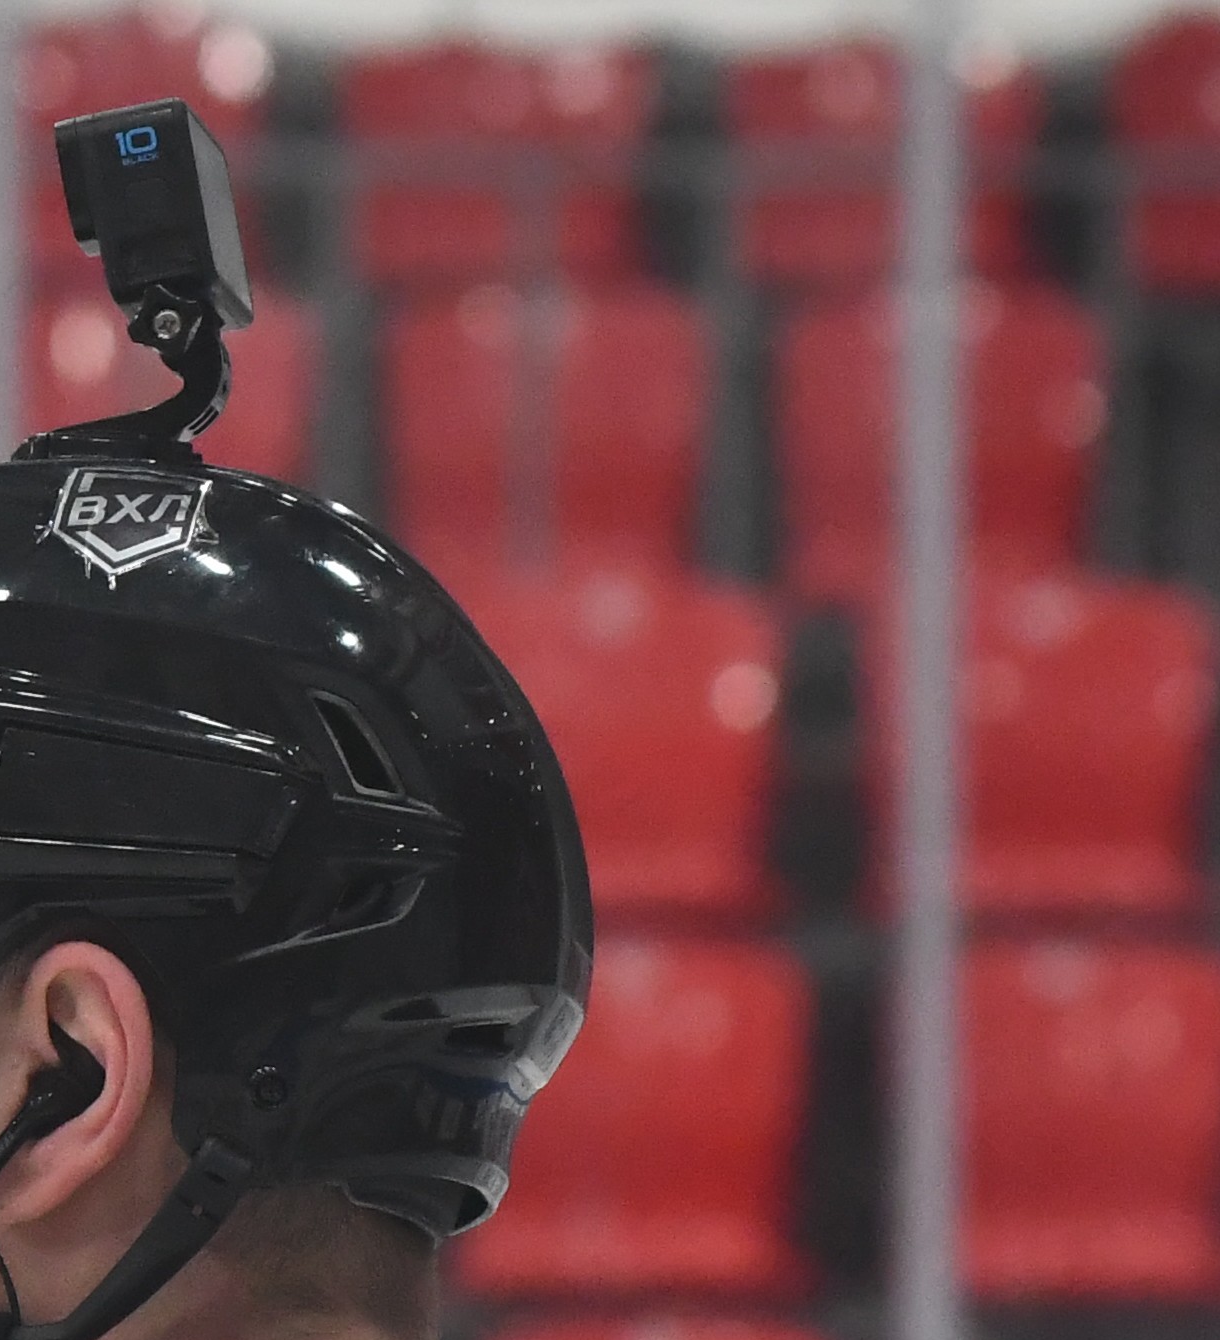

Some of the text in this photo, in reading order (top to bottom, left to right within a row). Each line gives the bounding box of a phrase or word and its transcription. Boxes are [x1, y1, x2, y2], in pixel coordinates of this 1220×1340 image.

[115, 126, 157, 156] 10
[122, 153, 159, 166] BLACK
[67, 494, 192, 526] ВХЛ
